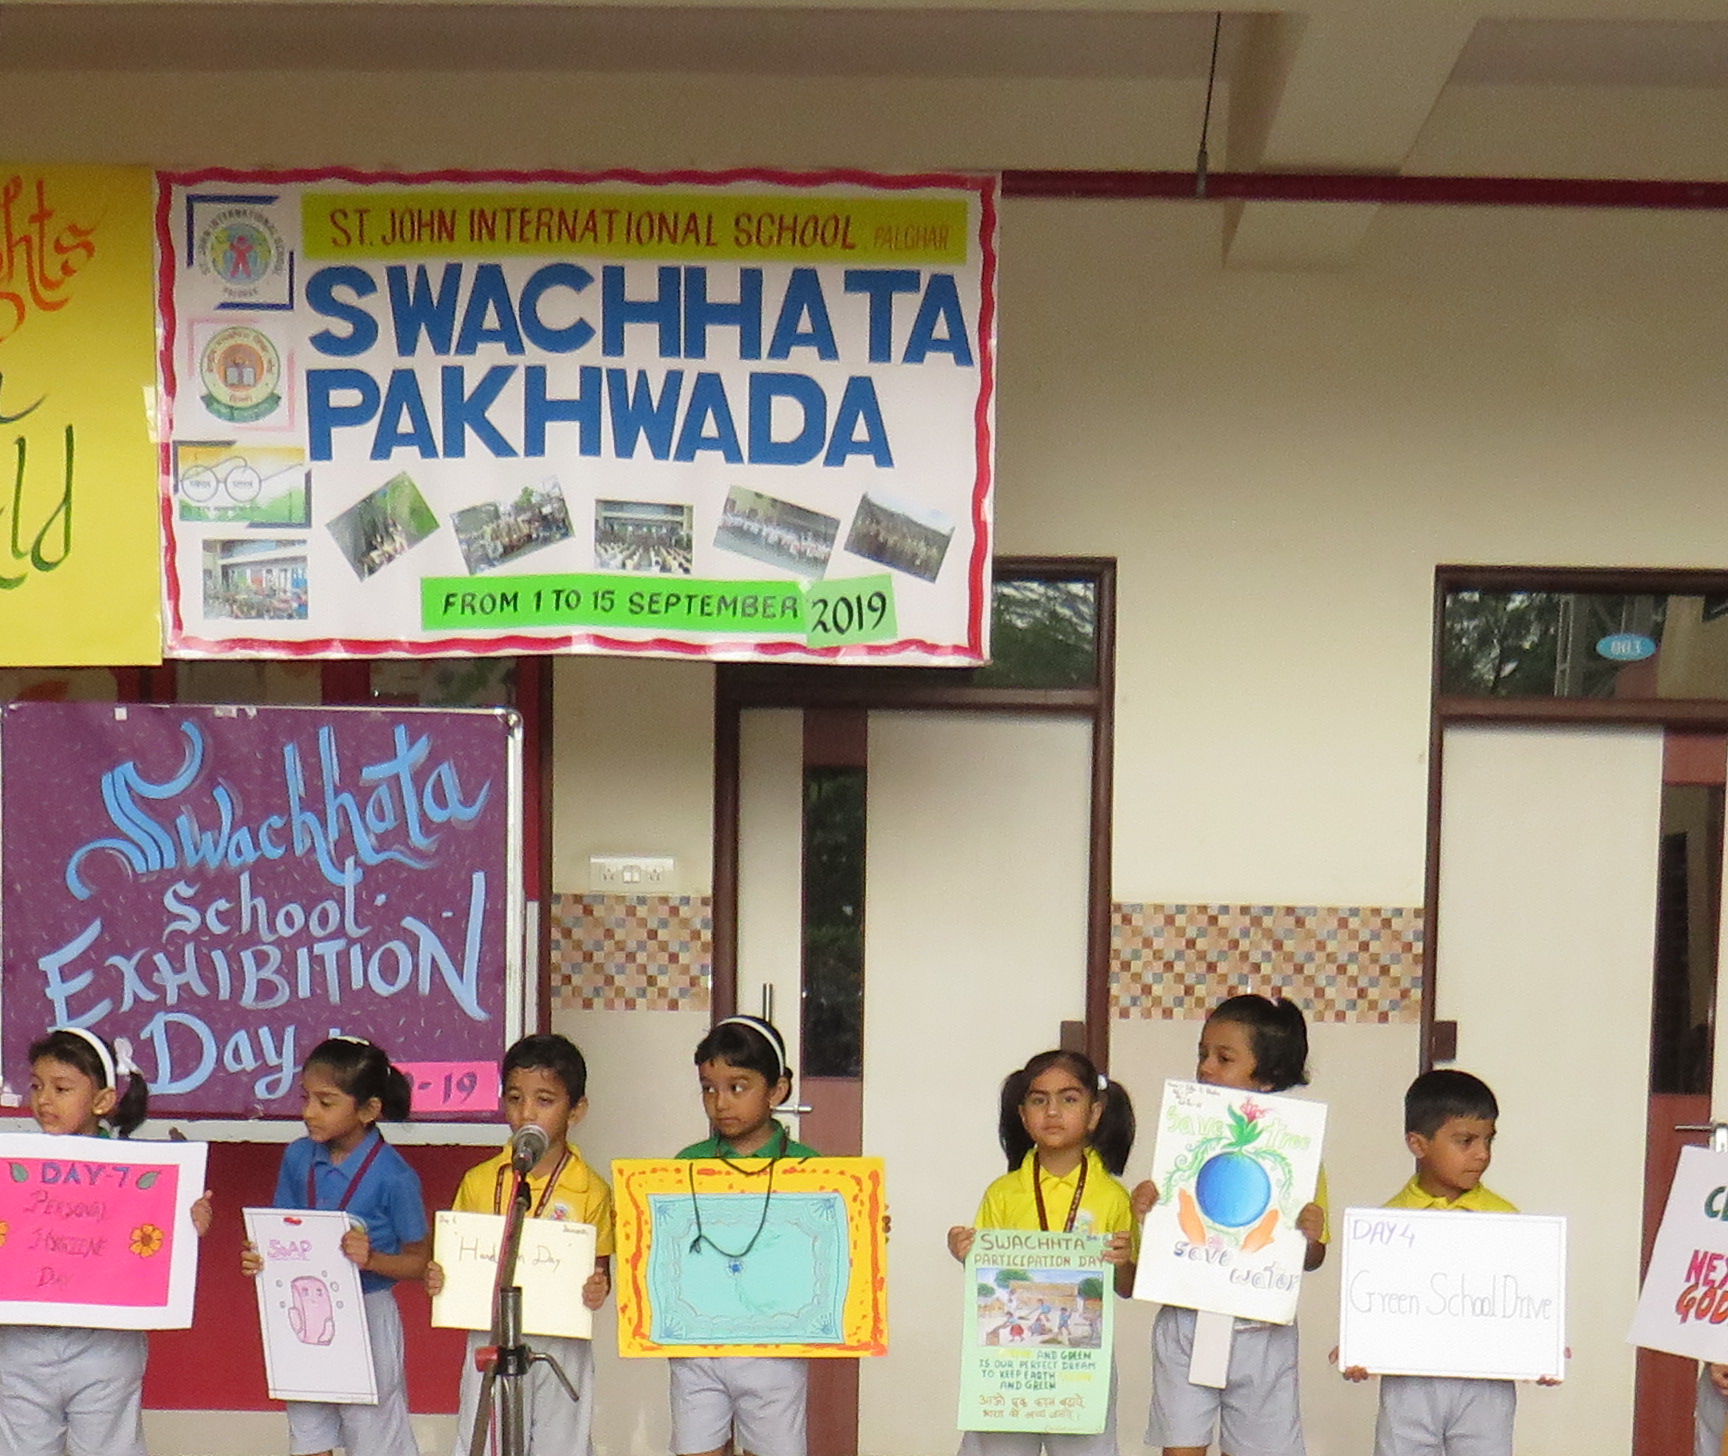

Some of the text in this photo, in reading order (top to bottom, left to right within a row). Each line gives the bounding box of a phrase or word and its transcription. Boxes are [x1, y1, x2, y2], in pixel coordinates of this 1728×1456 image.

[329, 208, 375, 247] ST.
[381, 208, 456, 246] JOHN
[468, 207, 718, 247] INTERNATIONAL
[733, 211, 857, 250] SCHOOL
[873, 224, 951, 252] PALGHAR
[305, 262, 974, 367] SWACHHATA
[305, 364, 895, 469] PAKHWADA
[442, 588, 801, 619] FROM 1 TO 15 SEPTEMBER
[811, 591, 888, 635] 2019
[65, 721, 491, 900] Swachhata
[162, 857, 373, 943] School
[38, 871, 492, 1033] EXHIBITION
[140, 1011, 304, 1100] Day
[1352, 1219, 1416, 1248] DAY 4
[532, 1244, 561, 1273] Day
[974, 1253, 1071, 1268] PARTICIPATION
[1350, 1269, 1553, 1320] Green School Drive
[994, 1360, 1014, 1369] OUR
[1062, 1361, 1096, 1370] DREAM
[1060, 1350, 1092, 1360] GREEN
